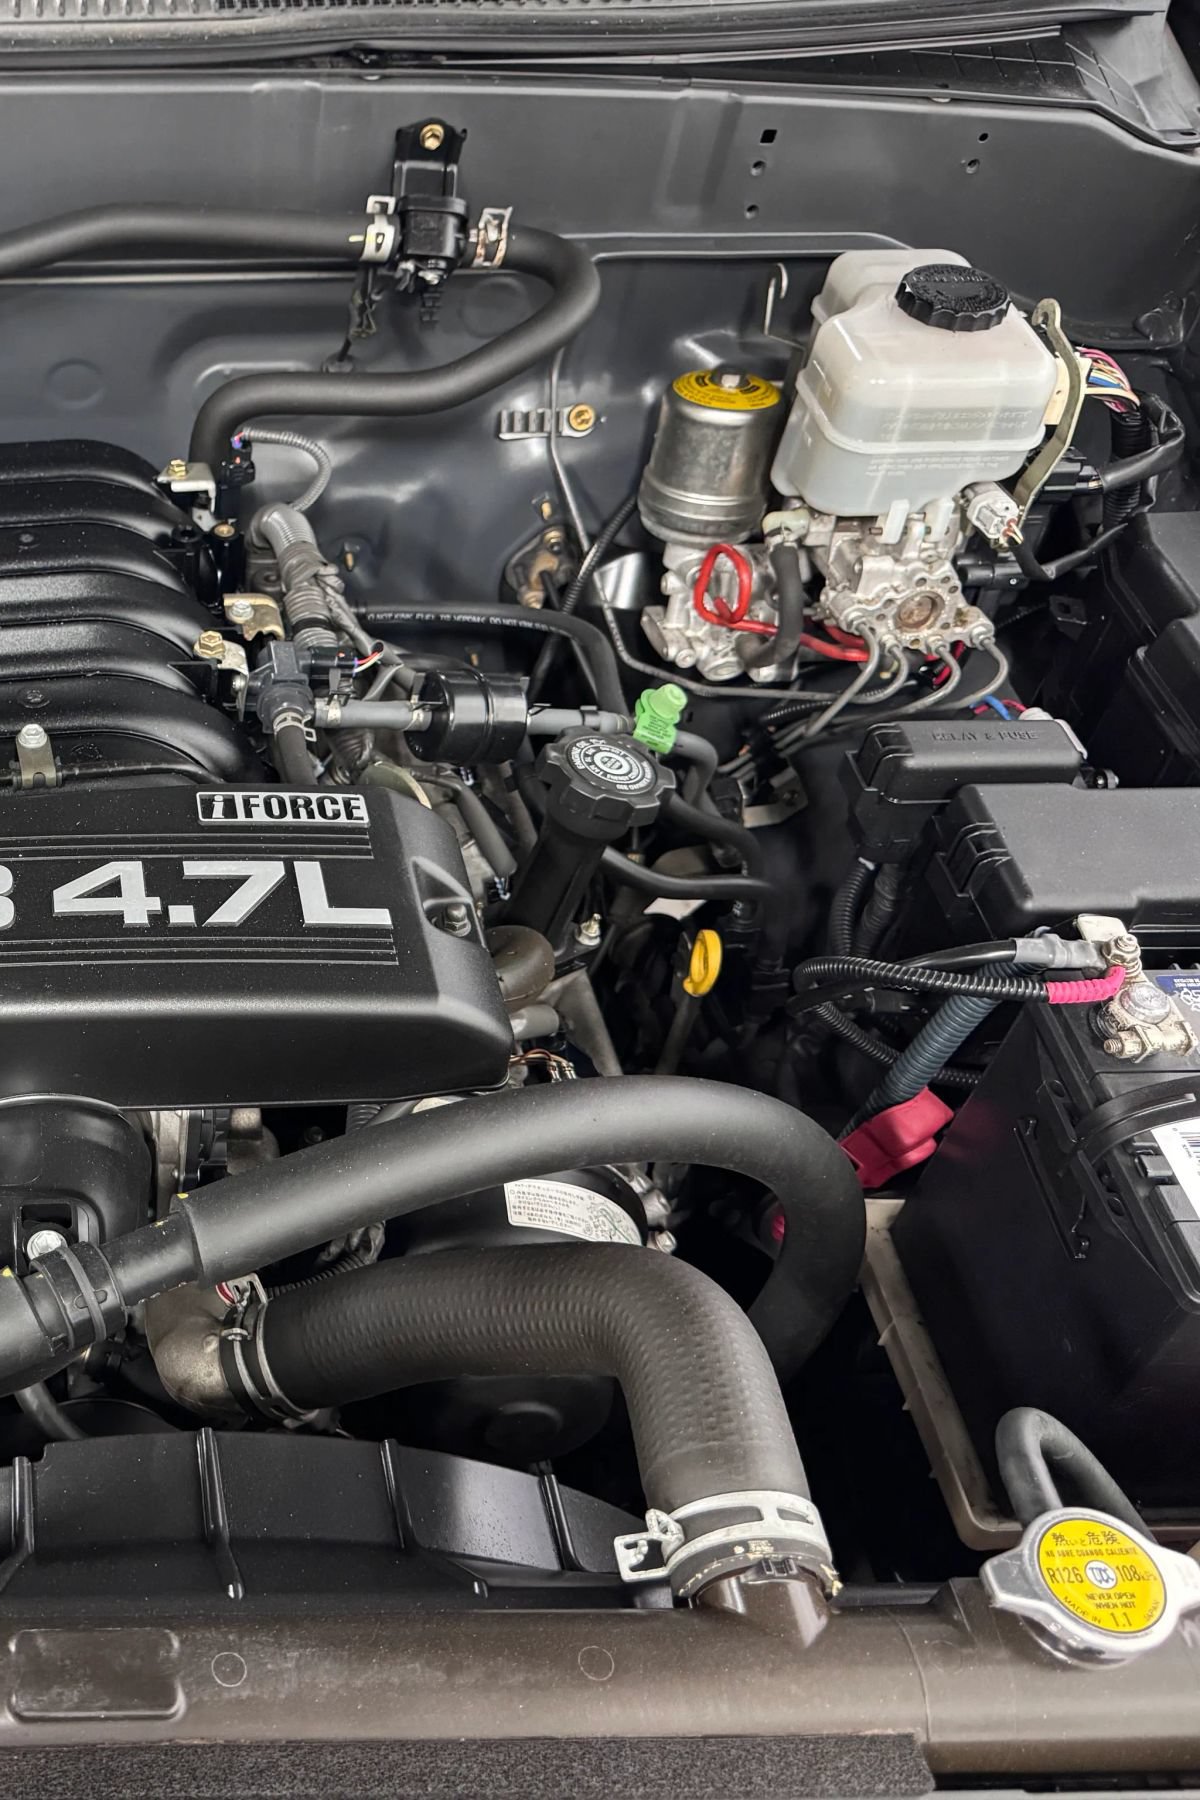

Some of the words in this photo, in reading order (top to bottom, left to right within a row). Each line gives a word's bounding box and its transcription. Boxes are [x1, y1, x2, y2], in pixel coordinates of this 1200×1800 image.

[931, 731, 977, 741] RELAY
[998, 731, 1040, 741] FUSE
[242, 794, 365, 821] FORCE
[52, 860, 393, 928] 4.7L
[1105, 1547, 1138, 1556] CALIENTE
[1046, 1566, 1084, 1584] R126
[1085, 1592, 1112, 1600] NEVER
[1113, 1592, 1136, 1600] OPEN
[1062, 1596, 1089, 1616] MADE
[1091, 1615, 1101, 1624] IN
[1093, 1601, 1119, 1609] WHEN
[1110, 1612, 1133, 1628] 1.1
